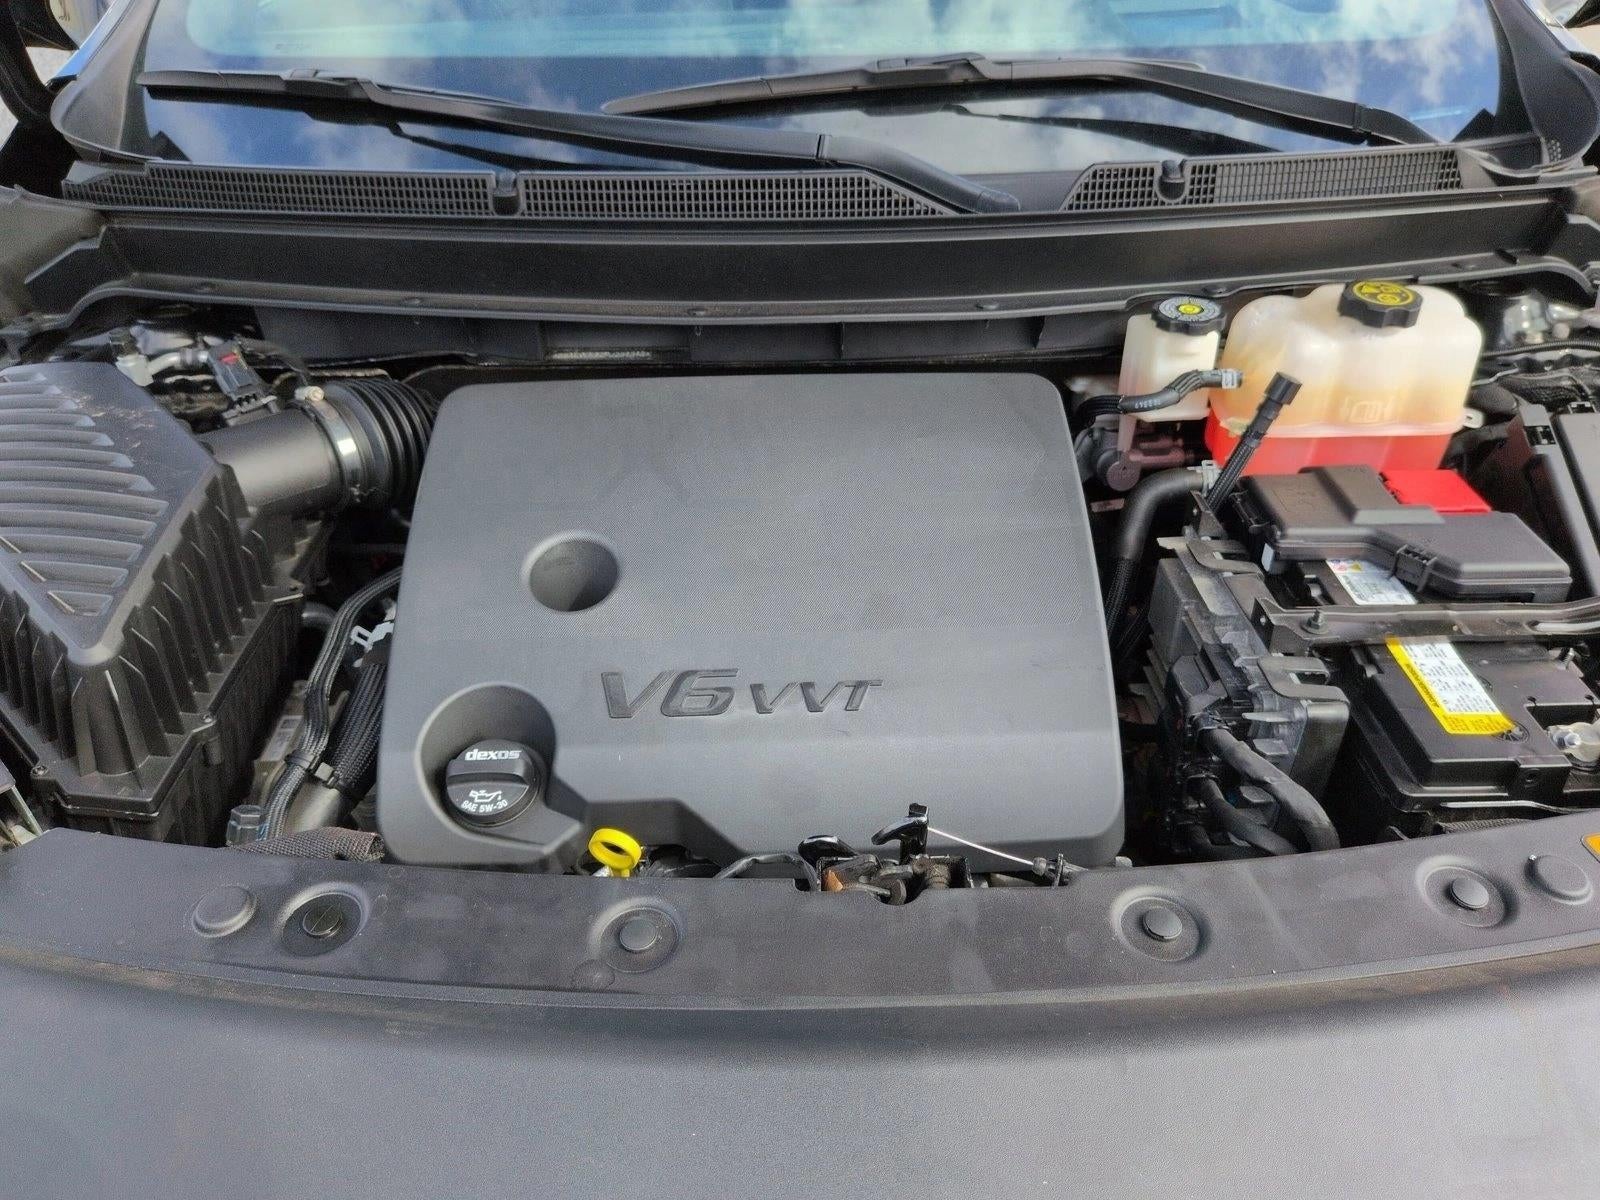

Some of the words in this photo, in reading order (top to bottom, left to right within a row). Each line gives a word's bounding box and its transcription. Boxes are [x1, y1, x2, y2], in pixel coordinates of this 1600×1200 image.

[601, 668, 738, 718] V6
[750, 680, 883, 714] VVT
[464, 748, 522, 761] dexos
[461, 800, 479, 812] SAE
[478, 799, 508, 813] 5W-30
